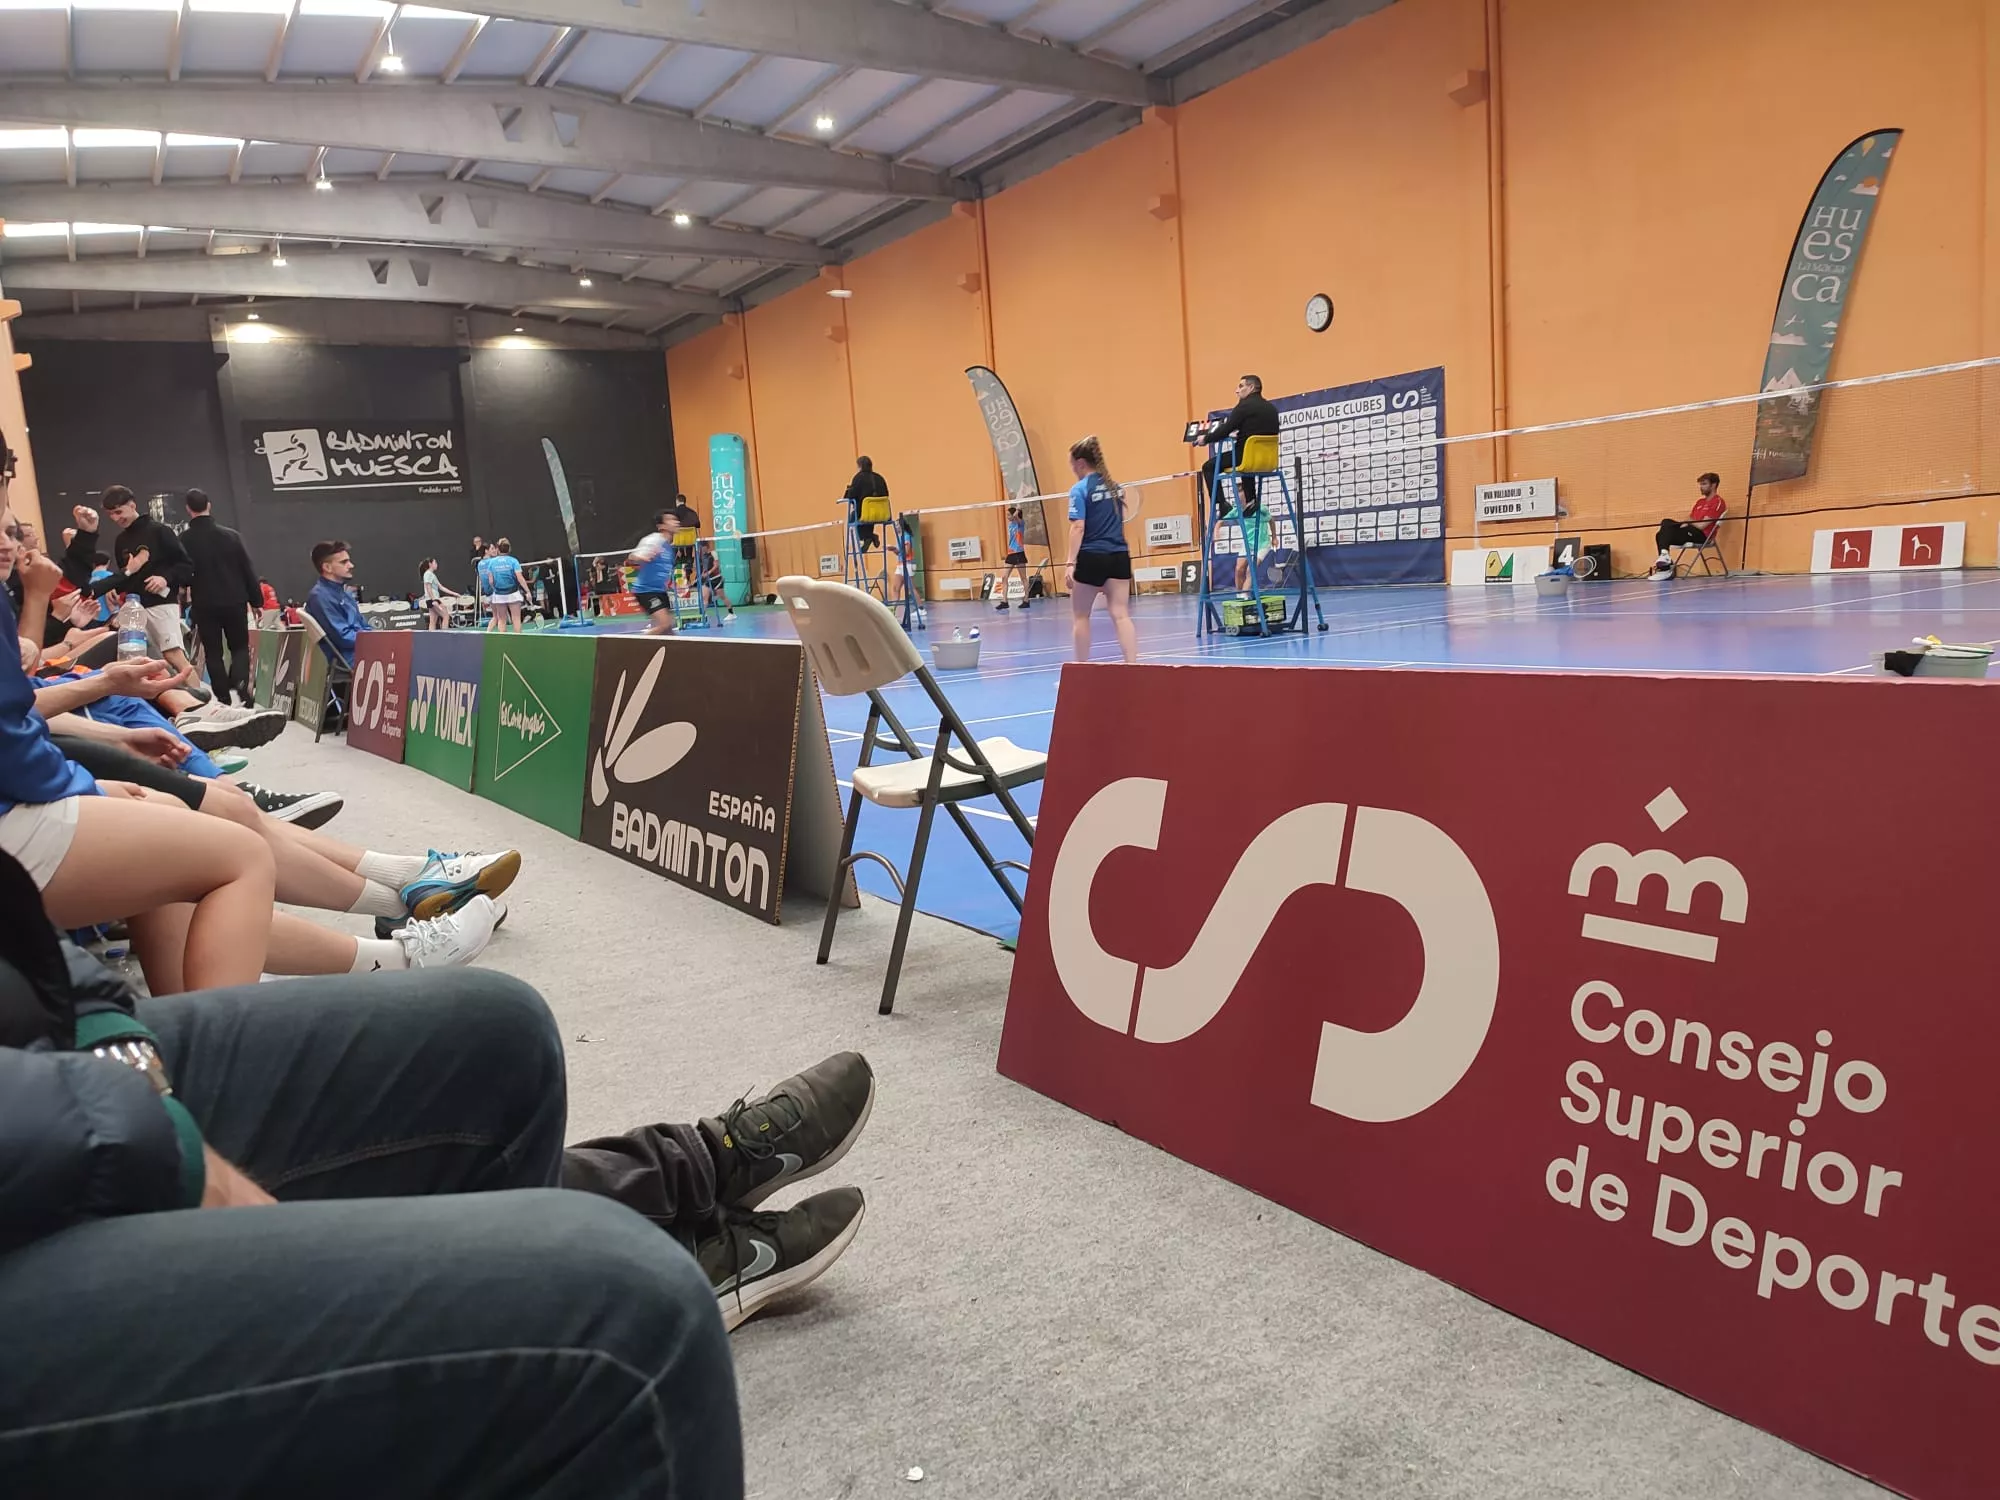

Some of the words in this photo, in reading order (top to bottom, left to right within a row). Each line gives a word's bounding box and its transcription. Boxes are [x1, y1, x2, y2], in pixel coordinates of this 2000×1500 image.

[1327, 407, 1341, 418] DE
[1343, 398, 1383, 415] CLUBES
[1188, 424, 1198, 436] 5
[330, 452, 459, 478] HUESCA
[1529, 486, 1535, 496] 3
[1484, 503, 1514, 515] OVIEDO
[1530, 501, 1535, 510] 1
[1558, 544, 1574, 566] 4
[983, 577, 991, 591] 2
[1185, 565, 1197, 582] 3
[434, 678, 478, 748] YONEX
[709, 790, 776, 834] ESPAÑA
[611, 800, 770, 911] BADMINTON
[1570, 979, 1888, 1118] Consejo
[1560, 1059, 1904, 1218] Superior
[1545, 1144, 1630, 1223] de
